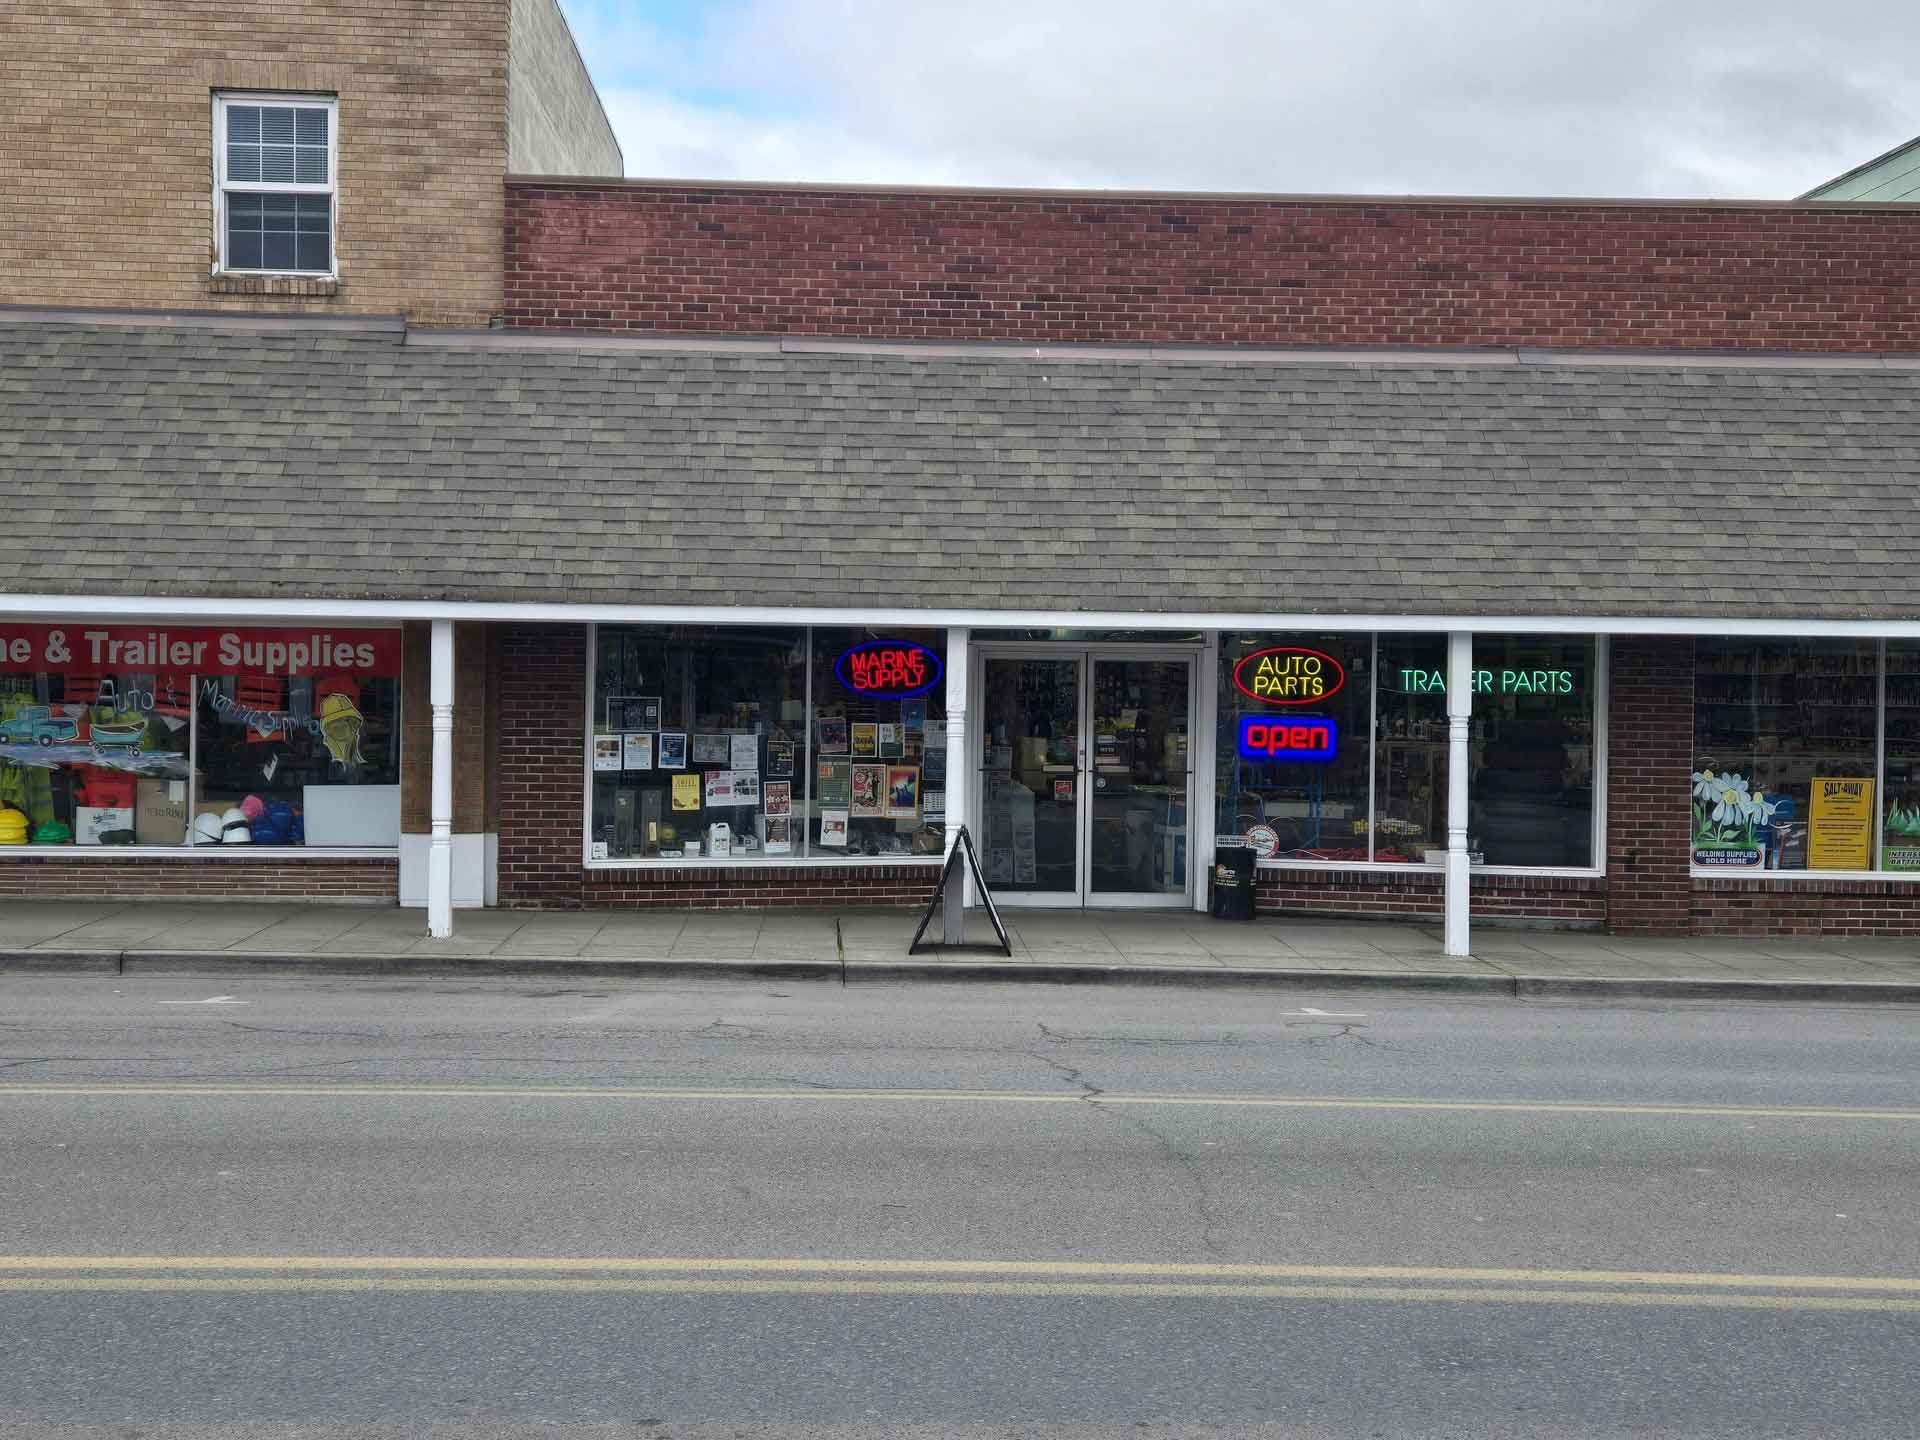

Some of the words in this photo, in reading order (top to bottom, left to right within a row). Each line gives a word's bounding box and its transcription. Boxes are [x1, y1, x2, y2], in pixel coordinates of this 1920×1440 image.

[45, 630, 72, 663] &
[84, 631, 207, 666] Trailer
[218, 633, 375, 675] Supplies
[851, 649, 923, 672] MARINE
[853, 664, 925, 689] SUPPLY
[1257, 656, 1321, 675] AUTO
[1254, 676, 1323, 696] PARTS
[1400, 670, 1493, 692] TRAR
[1503, 671, 1572, 693] PARTS
[1247, 725, 1328, 756] open
[1696, 850, 1725, 858] WELDING
[1726, 850, 1758, 858] SUPPLIES
